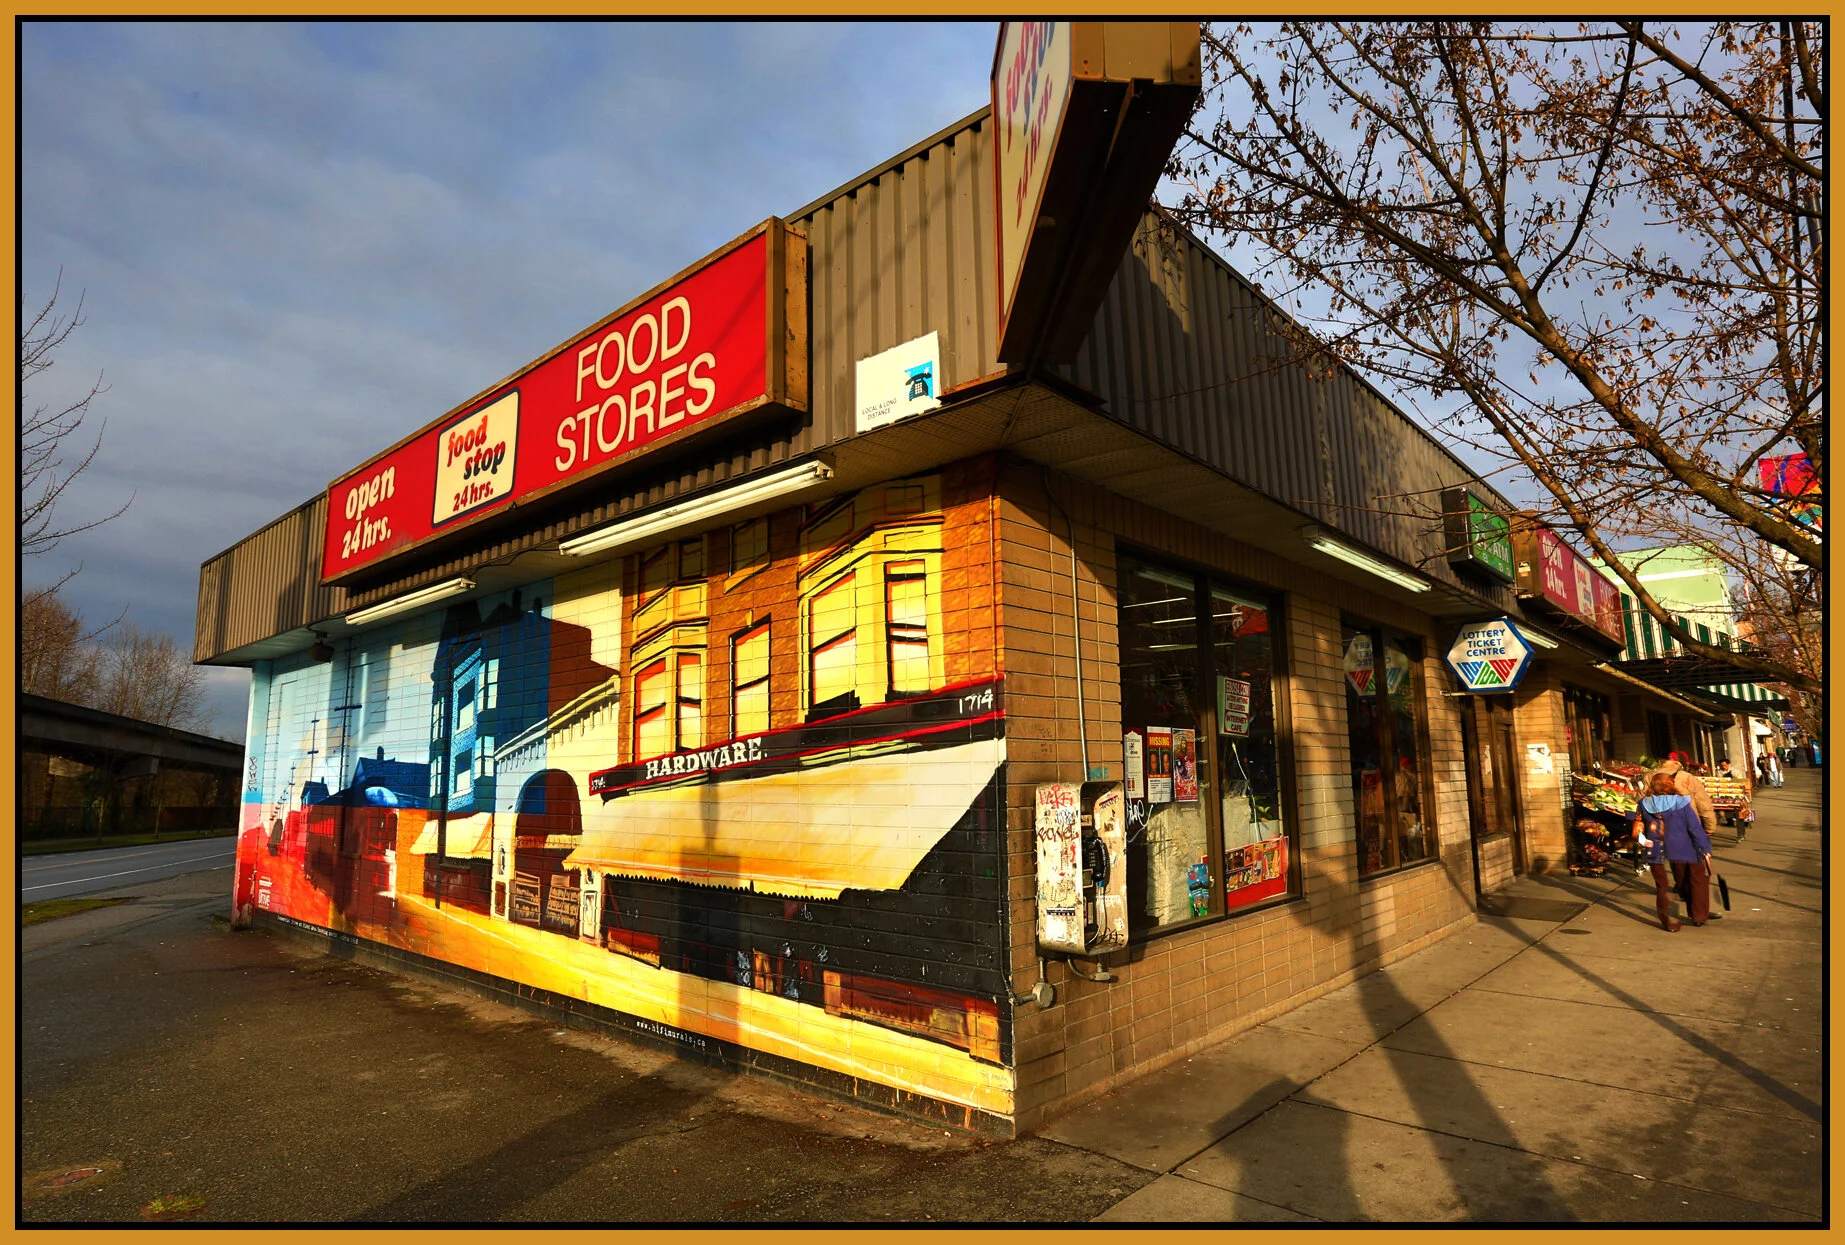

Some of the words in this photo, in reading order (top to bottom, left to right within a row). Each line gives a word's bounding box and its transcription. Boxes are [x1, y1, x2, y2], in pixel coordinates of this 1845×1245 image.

[1005, 22, 1035, 153] foo
[576, 296, 691, 403] FOOD
[555, 352, 716, 472] STORES
[862, 405, 878, 414] LOCAL
[884, 398, 897, 407] LONG
[868, 408, 890, 419] DISTANCE
[446, 415, 489, 468] food
[463, 441, 506, 480] stop
[345, 466, 395, 520] open
[1493, 541, 1509, 564] ATM
[1542, 535, 1563, 571] open
[1463, 629, 1506, 640] LOTTERY
[1467, 638, 1502, 648] TICKET
[1466, 647, 1506, 657] CENTRE
[959, 688, 994, 714] 1714
[1225, 714, 1247, 725] INTERNET
[1230, 723, 1243, 733] CAFE
[1149, 736, 1170, 747] MISSING
[645, 736, 768, 780] HARDWARE.
[636, 1020, 706, 1047] www.hifimurals.ca
